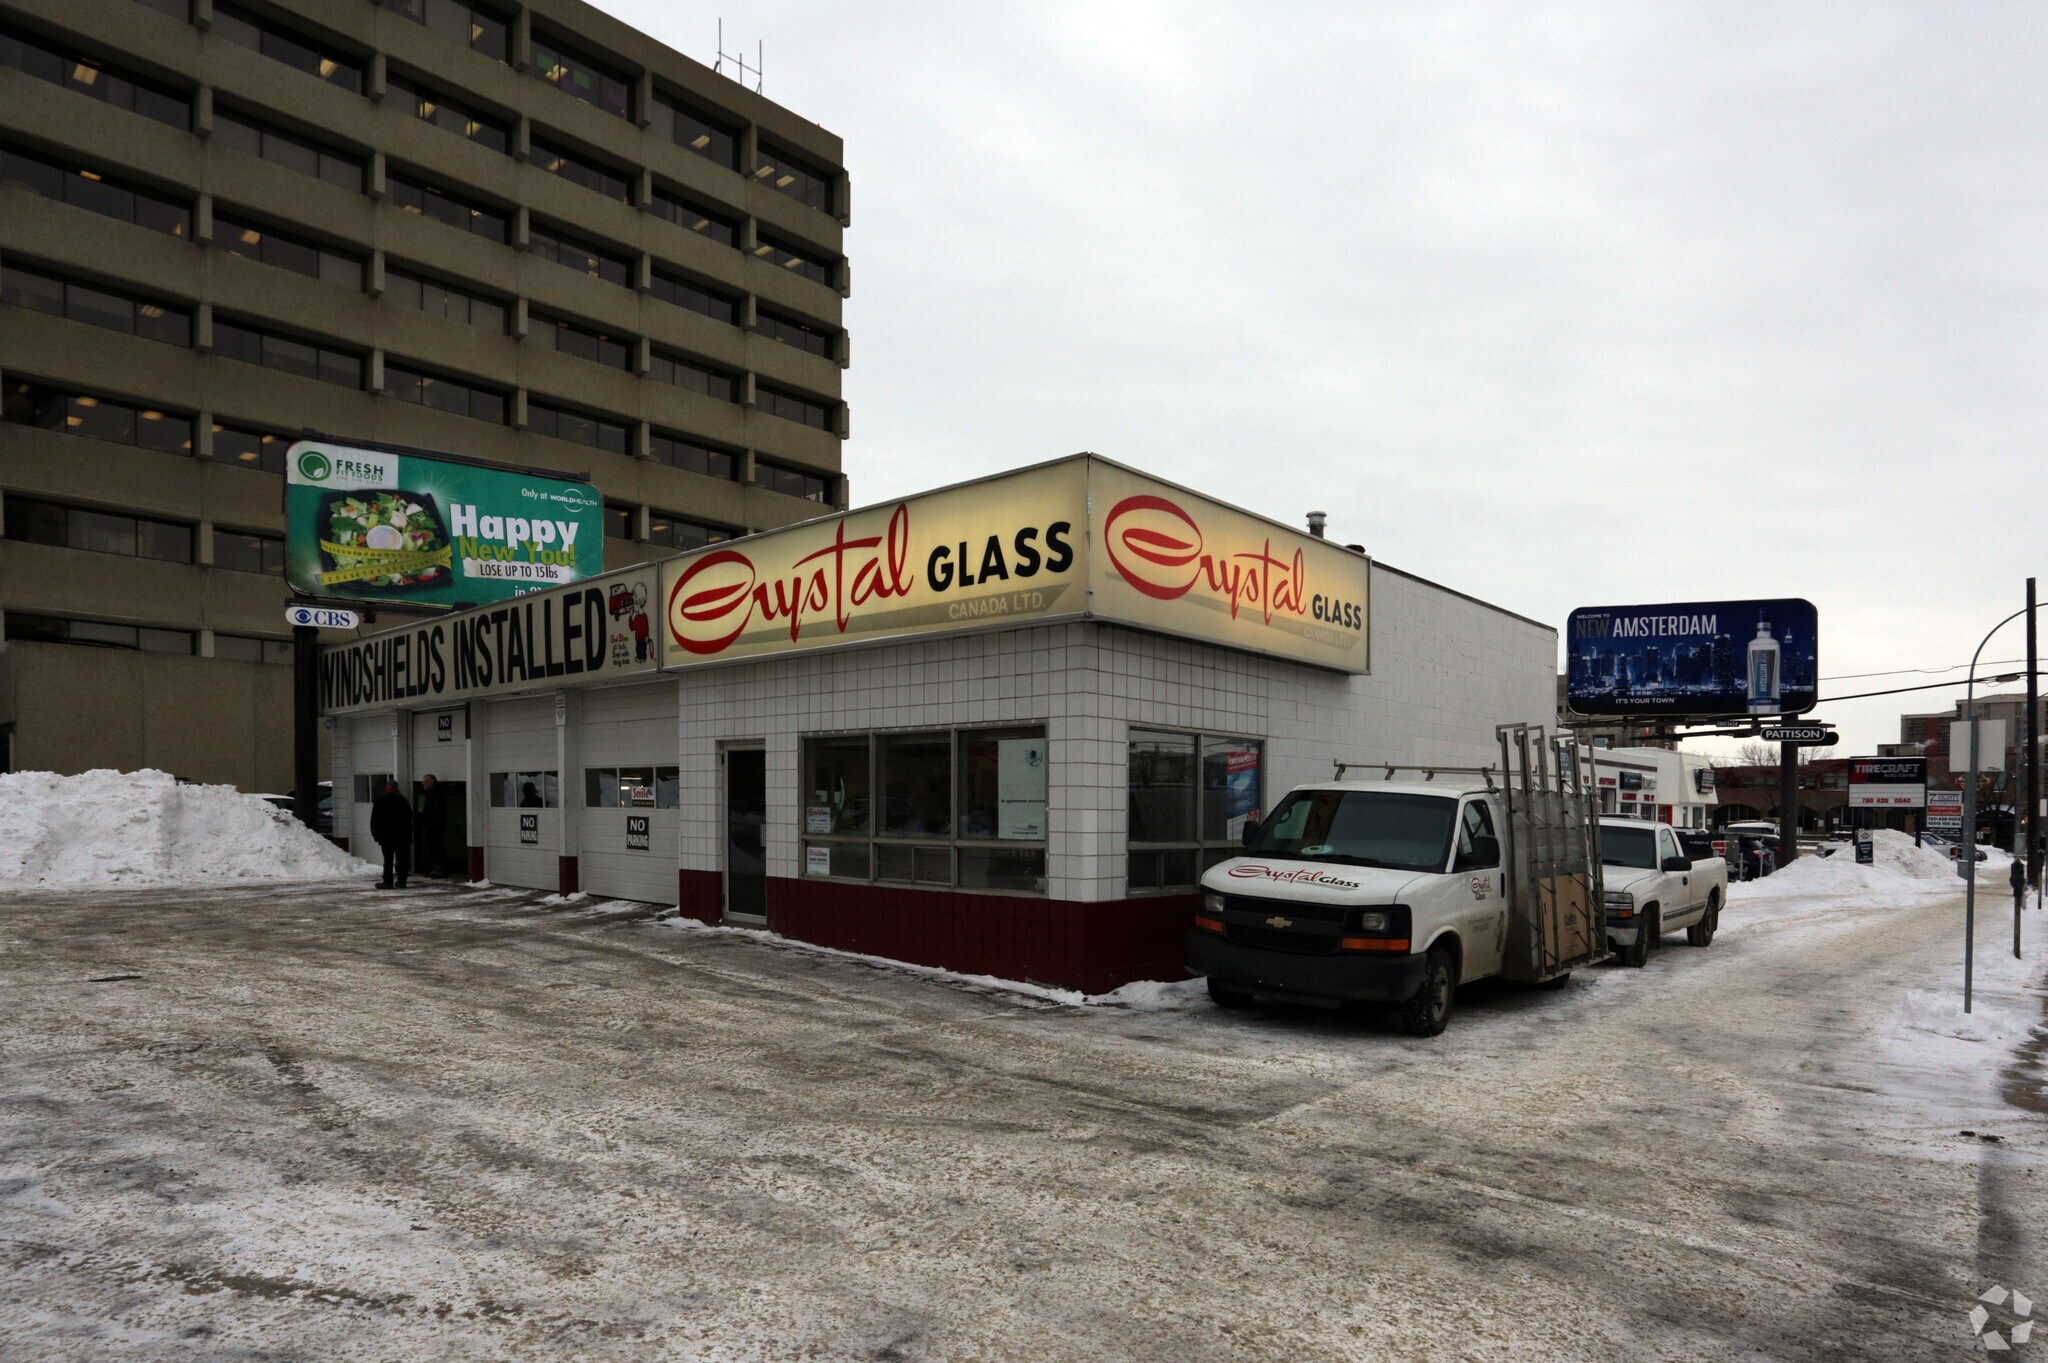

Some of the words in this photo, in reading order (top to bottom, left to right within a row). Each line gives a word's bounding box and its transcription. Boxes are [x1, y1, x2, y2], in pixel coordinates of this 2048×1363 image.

[336, 459, 384, 475] FRESH
[352, 471, 383, 481] FOODS
[522, 488, 538, 500] Only
[549, 494, 598, 507] WORLDHEALTH
[450, 503, 579, 553] Happy
[459, 535, 515, 562] New
[522, 541, 576, 567] You!
[927, 521, 1074, 592] GLASS
[1104, 495, 1306, 626] Crystal
[480, 564, 502, 576] LOSE
[505, 567, 516, 577] UP
[520, 569, 532, 577] TO
[535, 569, 559, 579] 15lbs
[669, 503, 914, 654] Crystal
[949, 598, 1008, 620] CANADA
[1013, 592, 1047, 612] LTD.
[1312, 594, 1362, 631] GLASS
[315, 611, 350, 627] CBS
[1576, 619, 1609, 640] NEW
[1612, 615, 1717, 638] AMSTERDAM
[1304, 626, 1333, 643] CANADA
[319, 625, 445, 709] WINDSHIELDS
[453, 588, 607, 690] INSTALLED
[1759, 664, 1768, 692] AMSTERDAM
[440, 718, 449, 727] NO
[1765, 729, 1820, 739] PATTISON
[1854, 764, 1920, 774] TIRECRAFT
[523, 817, 535, 828] NO
[630, 819, 645, 831] NO
[628, 834, 648, 847] PARKING
[1228, 865, 1323, 884] Crystal
[1318, 877, 1360, 888] Glass
